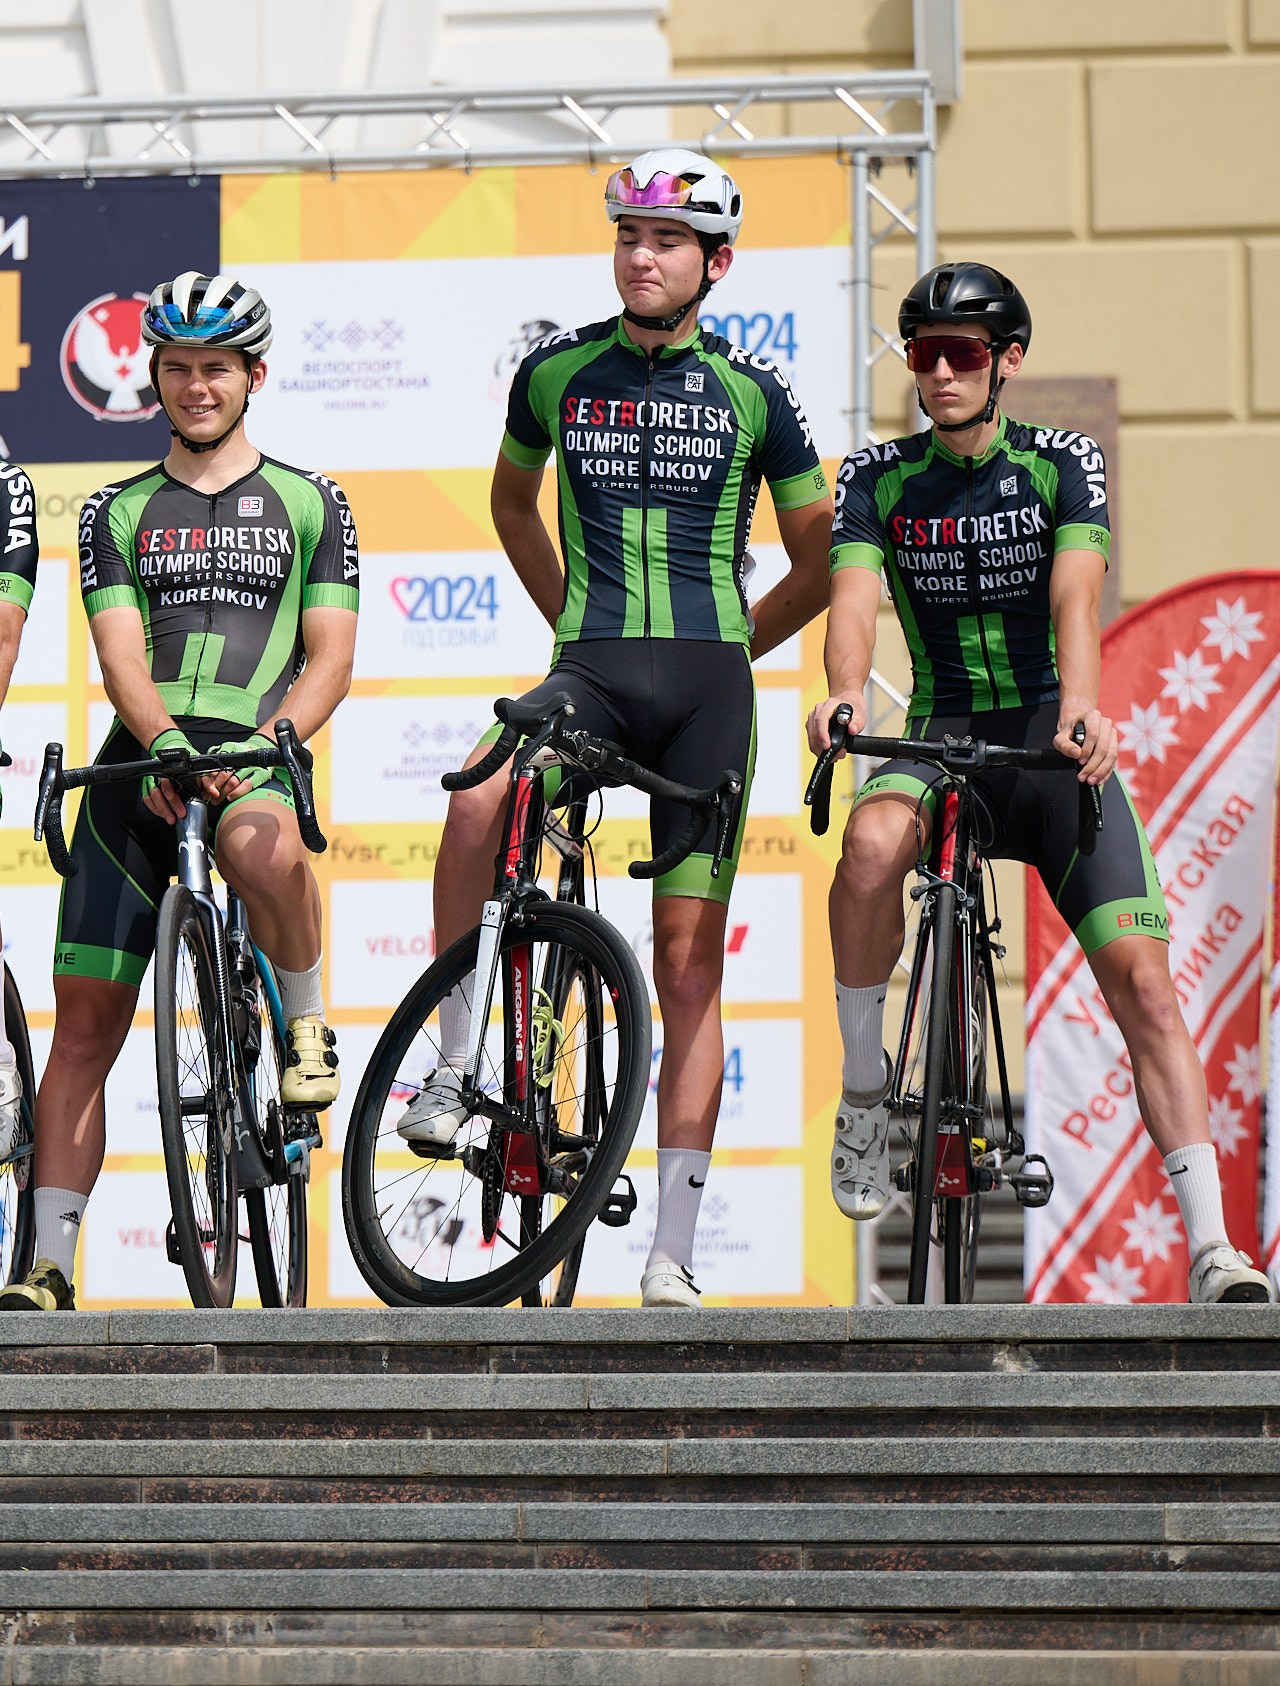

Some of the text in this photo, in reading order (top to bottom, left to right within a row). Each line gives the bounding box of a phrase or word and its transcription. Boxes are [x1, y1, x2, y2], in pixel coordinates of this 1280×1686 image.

[687, 374, 702, 383] FAT
[687, 382, 702, 390] CAT
[566, 430, 725, 459] OLYMPIC SCHOOL
[1035, 428, 1107, 509] RUSSIA
[831, 441, 903, 532] RUSSIA
[1002, 478, 1016, 488] FAT
[1003, 486, 1018, 496] CAT
[79, 484, 123, 590] RUSSIA
[138, 527, 293, 555] SESTRORETSK
[1089, 529, 1105, 538] FAT
[1089, 536, 1104, 546] CAT
[140, 552, 285, 579] OLYMPIC SCHOOL
[897, 541, 1047, 571] OLYMPIC SCHOOL
[144, 572, 278, 589] ST. PETERSBURG
[160, 586, 268, 611] KORENKOV
[407, 575, 499, 622] 2024
[1116, 911, 1169, 931] BIEM
[515, 966, 523, 1039] ARGON
